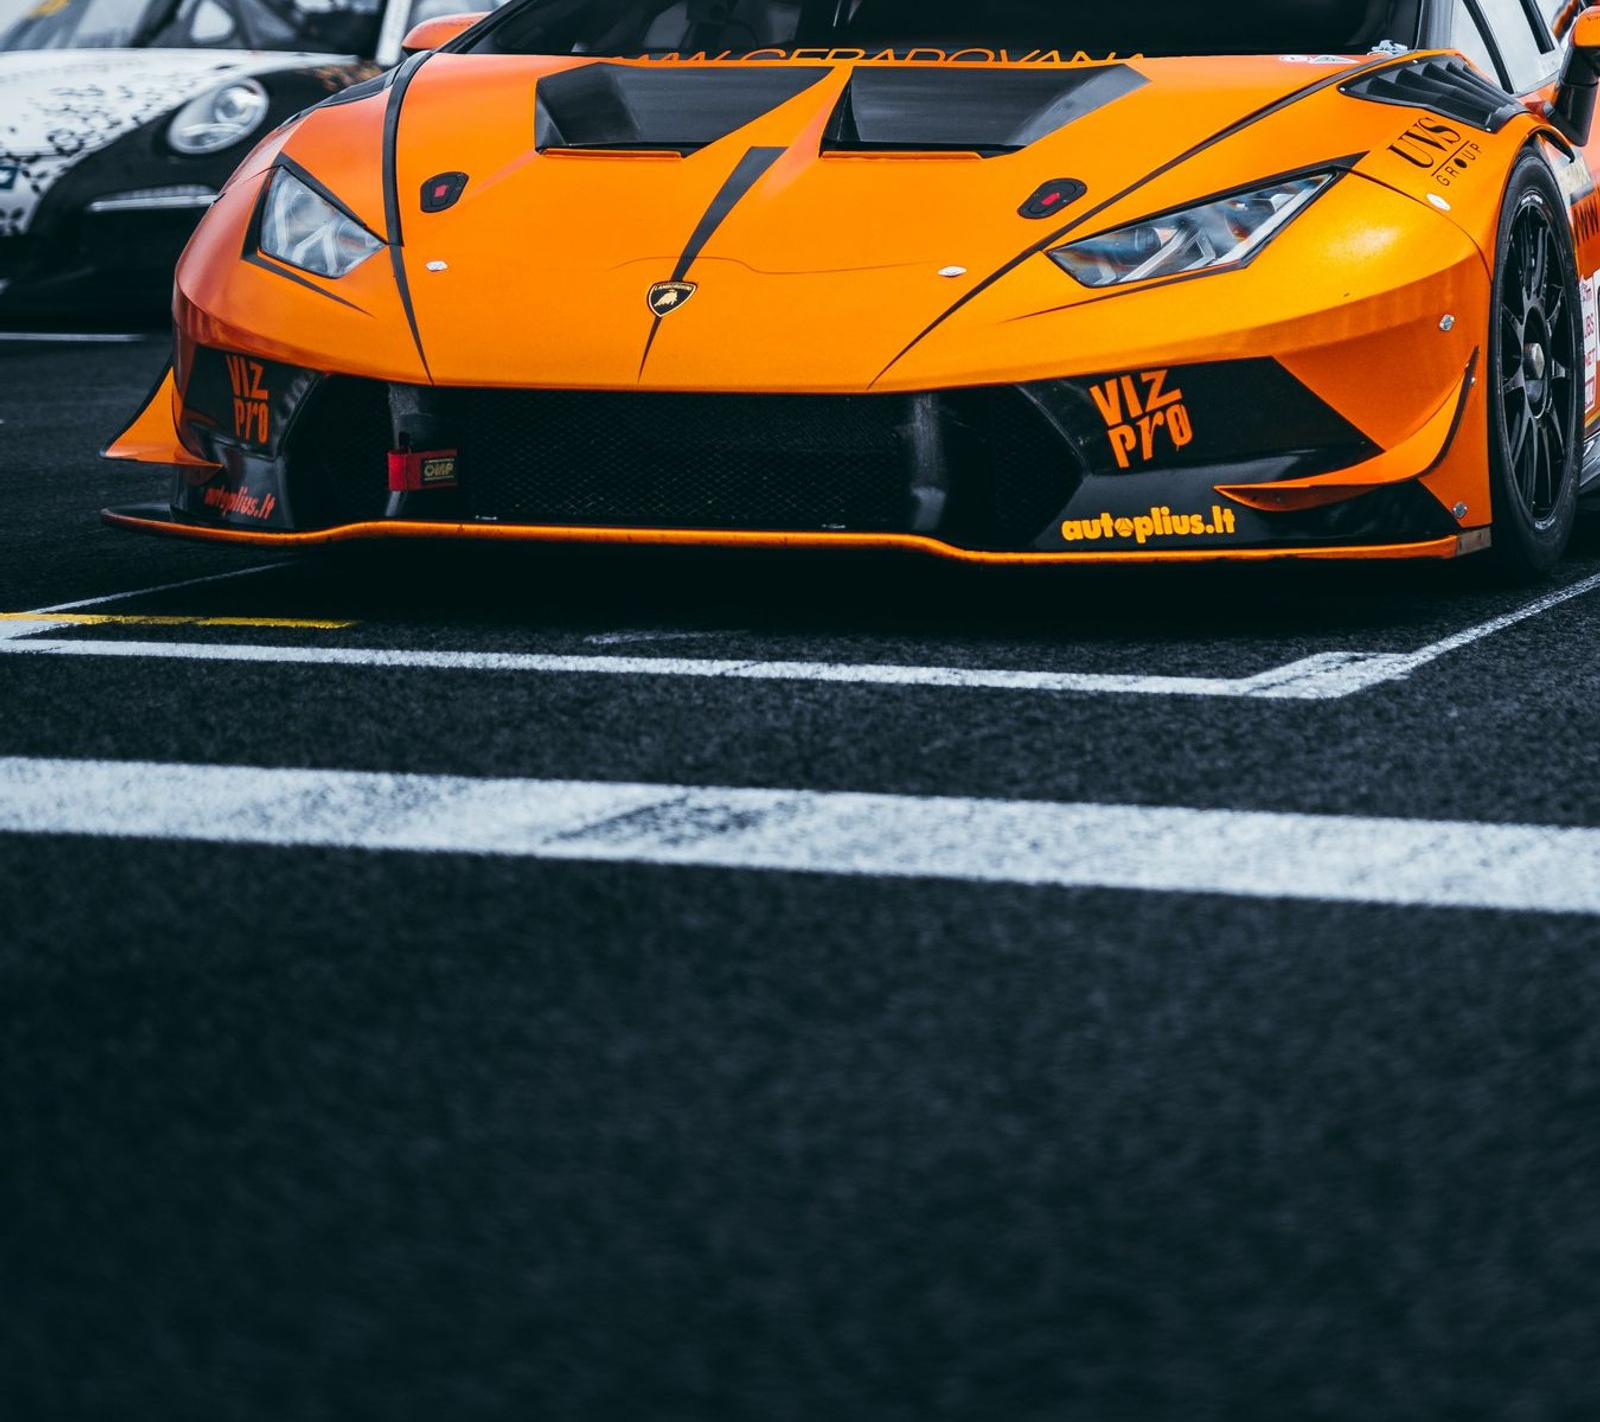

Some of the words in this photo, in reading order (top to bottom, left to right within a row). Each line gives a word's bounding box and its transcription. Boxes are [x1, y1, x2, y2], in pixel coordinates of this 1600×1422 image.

[1386, 117, 1462, 168] UVS
[1436, 142, 1483, 187] GROUP
[225, 353, 269, 401] VIZ
[1089, 369, 1183, 427] VIZ
[1061, 505, 1236, 544] autoplius.lt
